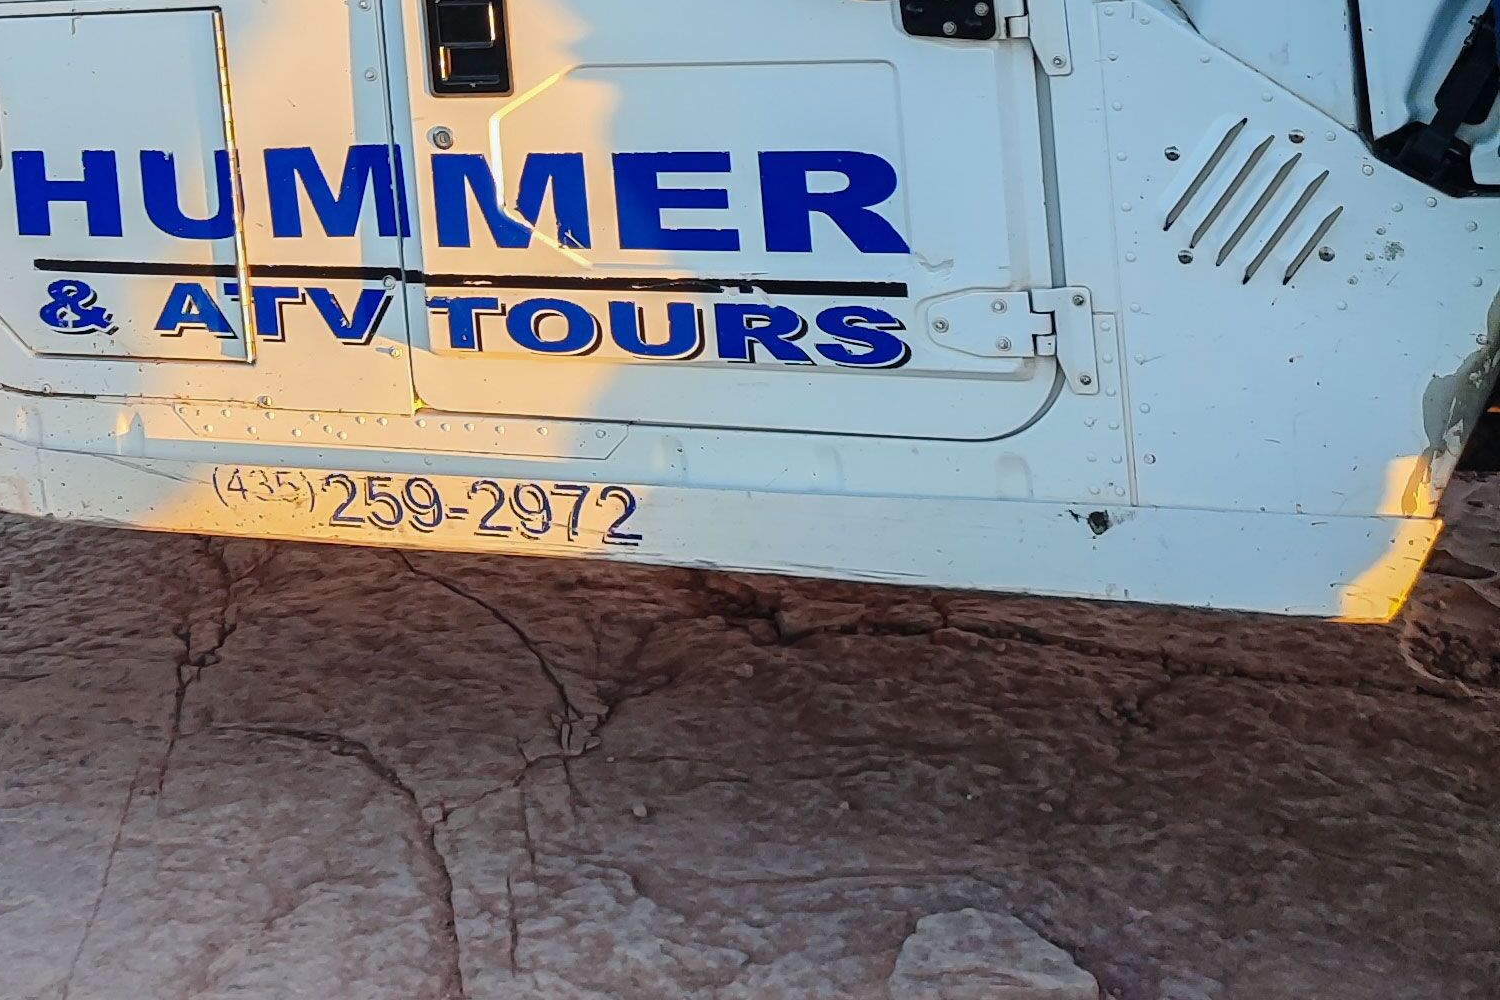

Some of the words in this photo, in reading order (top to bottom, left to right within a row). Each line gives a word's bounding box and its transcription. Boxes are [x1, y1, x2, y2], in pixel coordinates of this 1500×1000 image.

[11, 143, 911, 254] HUMMER
[39, 278, 118, 335] &
[153, 281, 395, 346] ATV
[426, 294, 911, 369] TOURS
